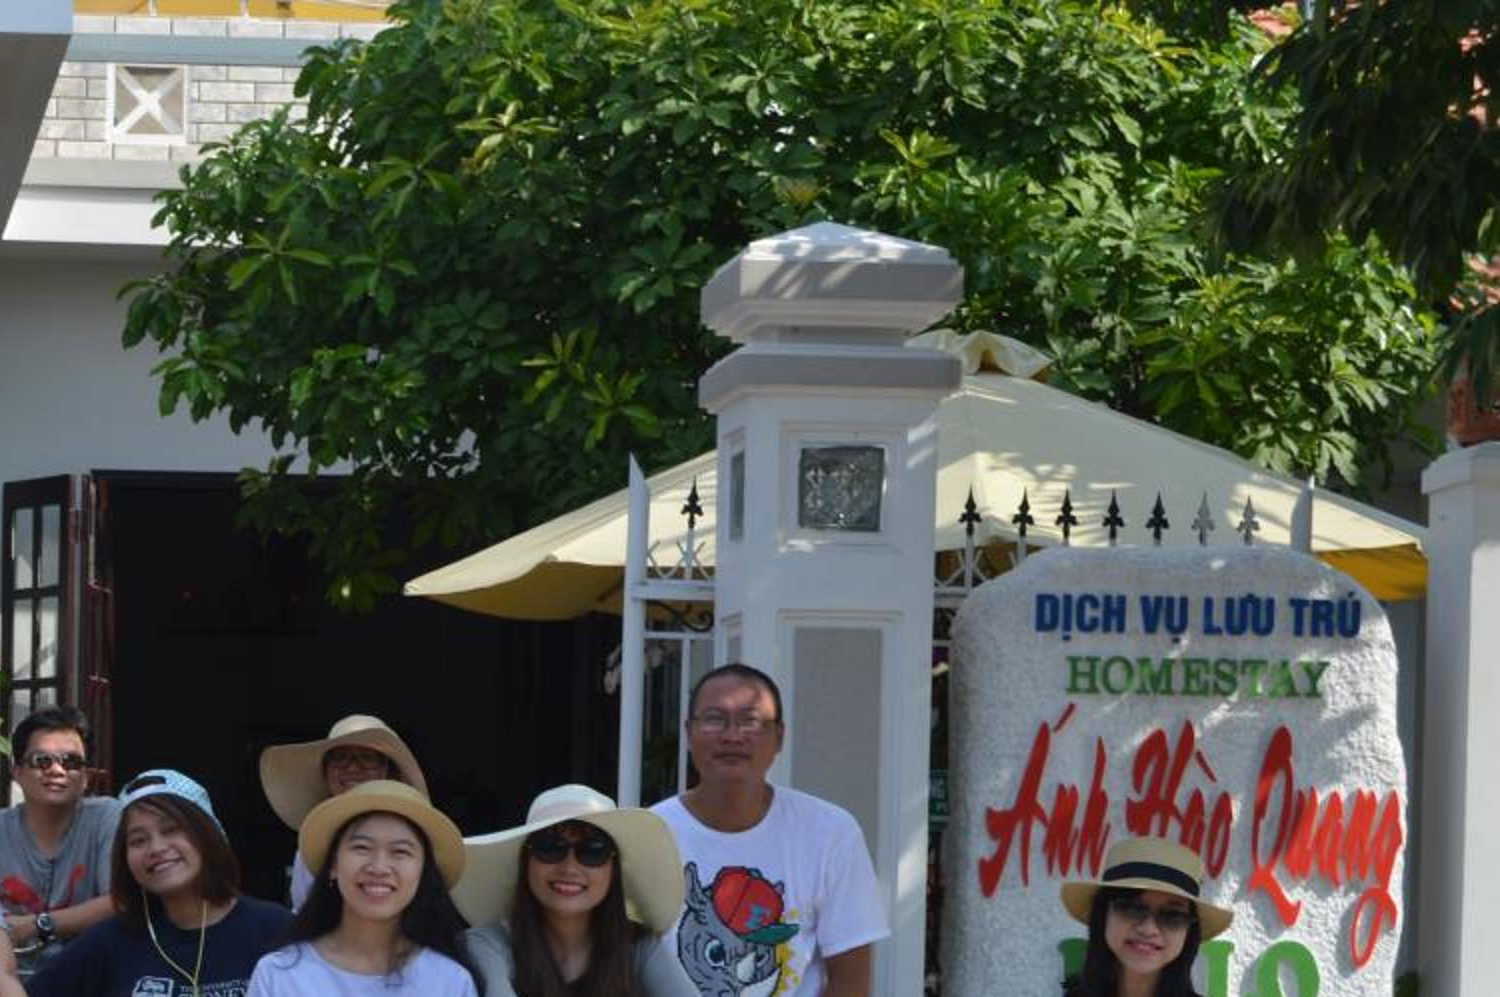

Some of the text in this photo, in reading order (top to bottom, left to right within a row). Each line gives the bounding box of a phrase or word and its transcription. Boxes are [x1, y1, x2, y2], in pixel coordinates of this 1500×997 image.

[1035, 590, 1363, 644] DỊCH VỤ LƯU TRÚ
[1064, 655, 1332, 700] HOMESTAY
[977, 702, 1111, 899] Ánh
[1247, 724, 1404, 970] Quang
